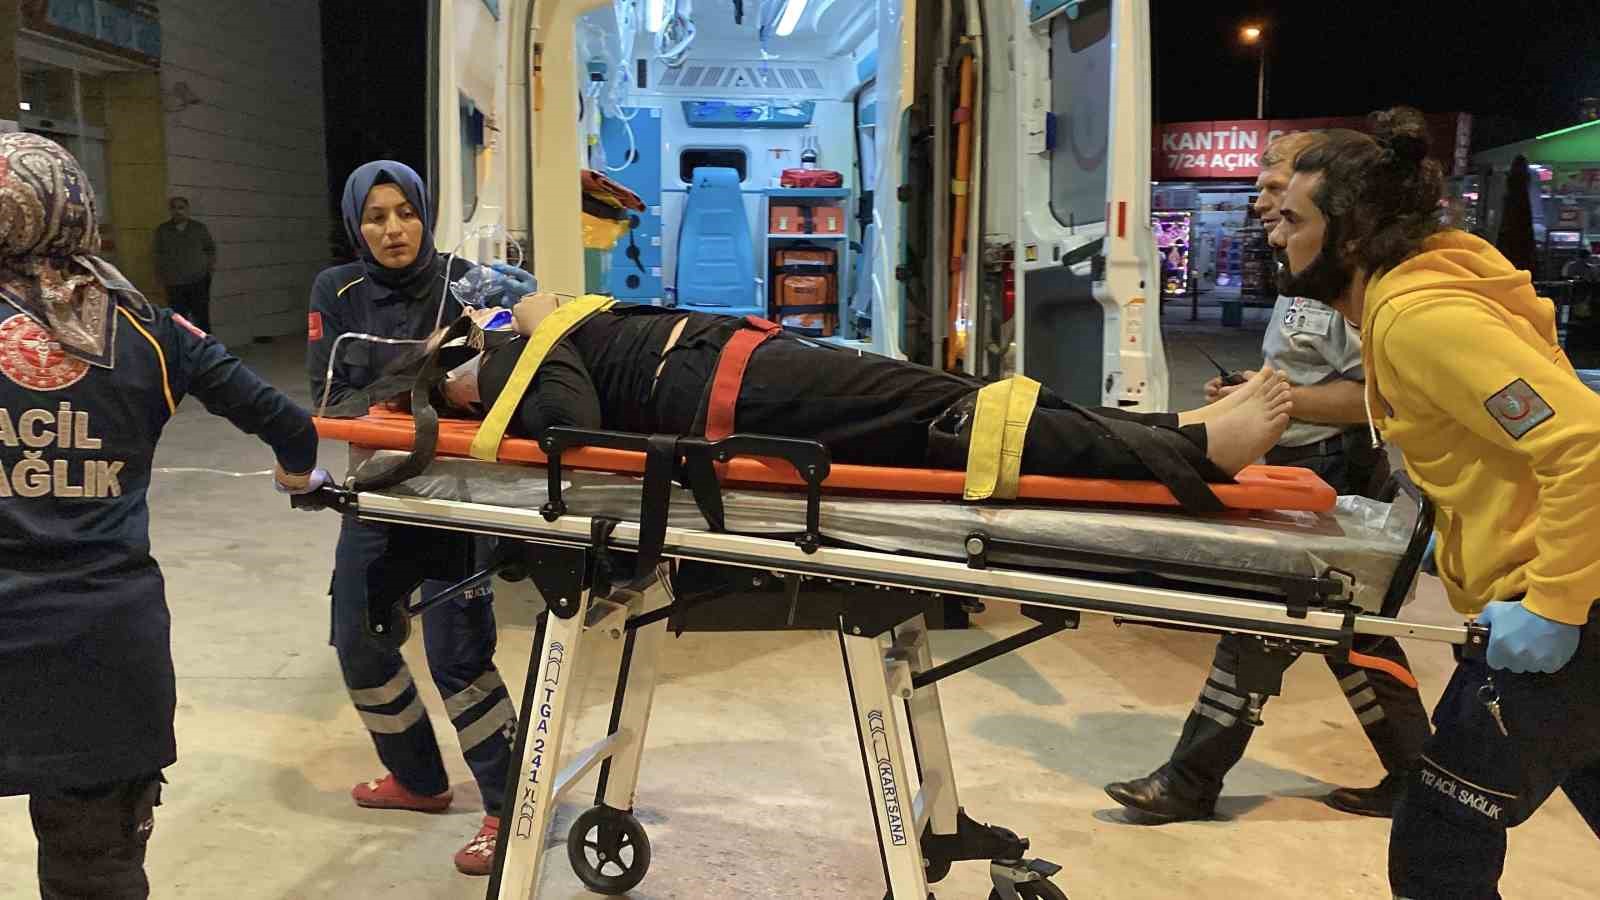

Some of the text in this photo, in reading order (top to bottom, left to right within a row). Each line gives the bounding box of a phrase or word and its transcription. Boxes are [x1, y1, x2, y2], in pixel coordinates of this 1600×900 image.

[1162, 126, 1258, 151] KANTİN
[1168, 153, 1259, 172] 7/24 AÇIK
[537, 688, 555, 734] TGA
[529, 739, 545, 784] 241
[880, 767, 904, 843] KARTSANA
[1433, 777, 1457, 799] ACİL
[1458, 789, 1503, 820] SAĞLIK
